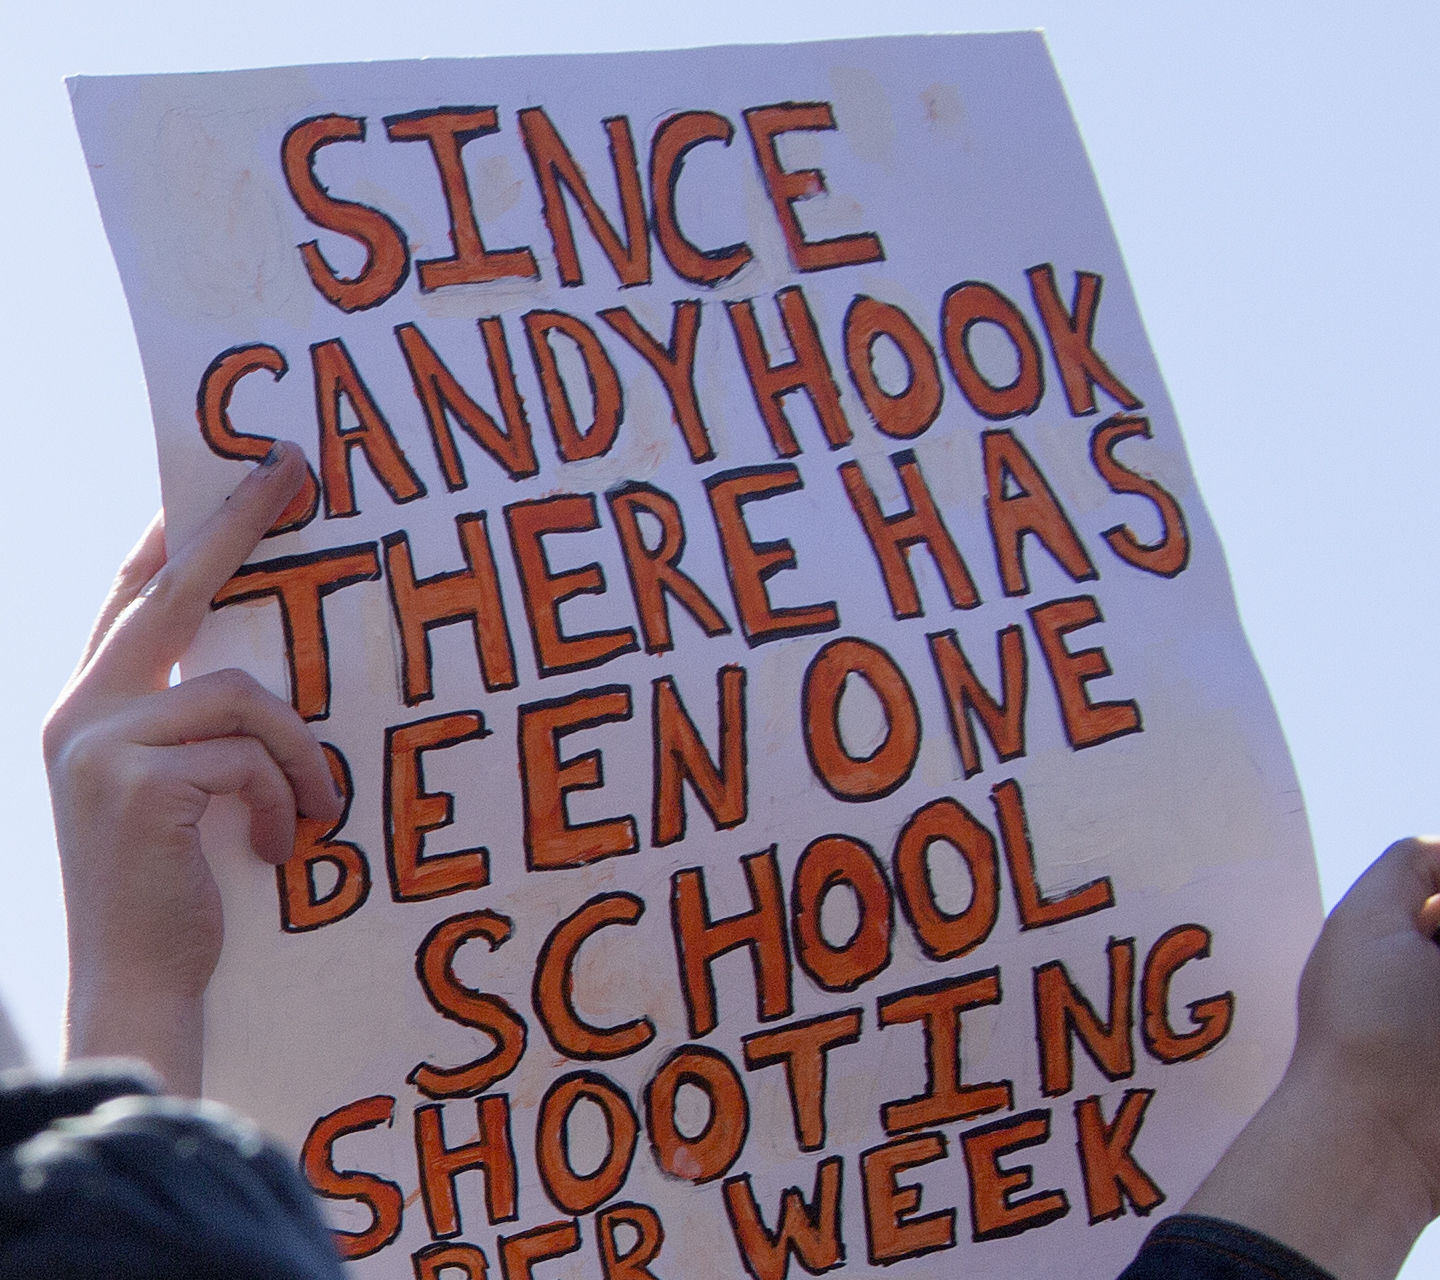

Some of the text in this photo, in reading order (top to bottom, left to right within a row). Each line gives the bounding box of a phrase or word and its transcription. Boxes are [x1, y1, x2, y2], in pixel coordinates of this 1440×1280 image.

[280, 101, 885, 314] SINCE
[211, 413, 1191, 722] THERE HAS
[277, 593, 1143, 933] BEEN ONE
[300, 922, 1238, 1260] SHOOTING
[409, 780, 1117, 1100] SCHOOL
